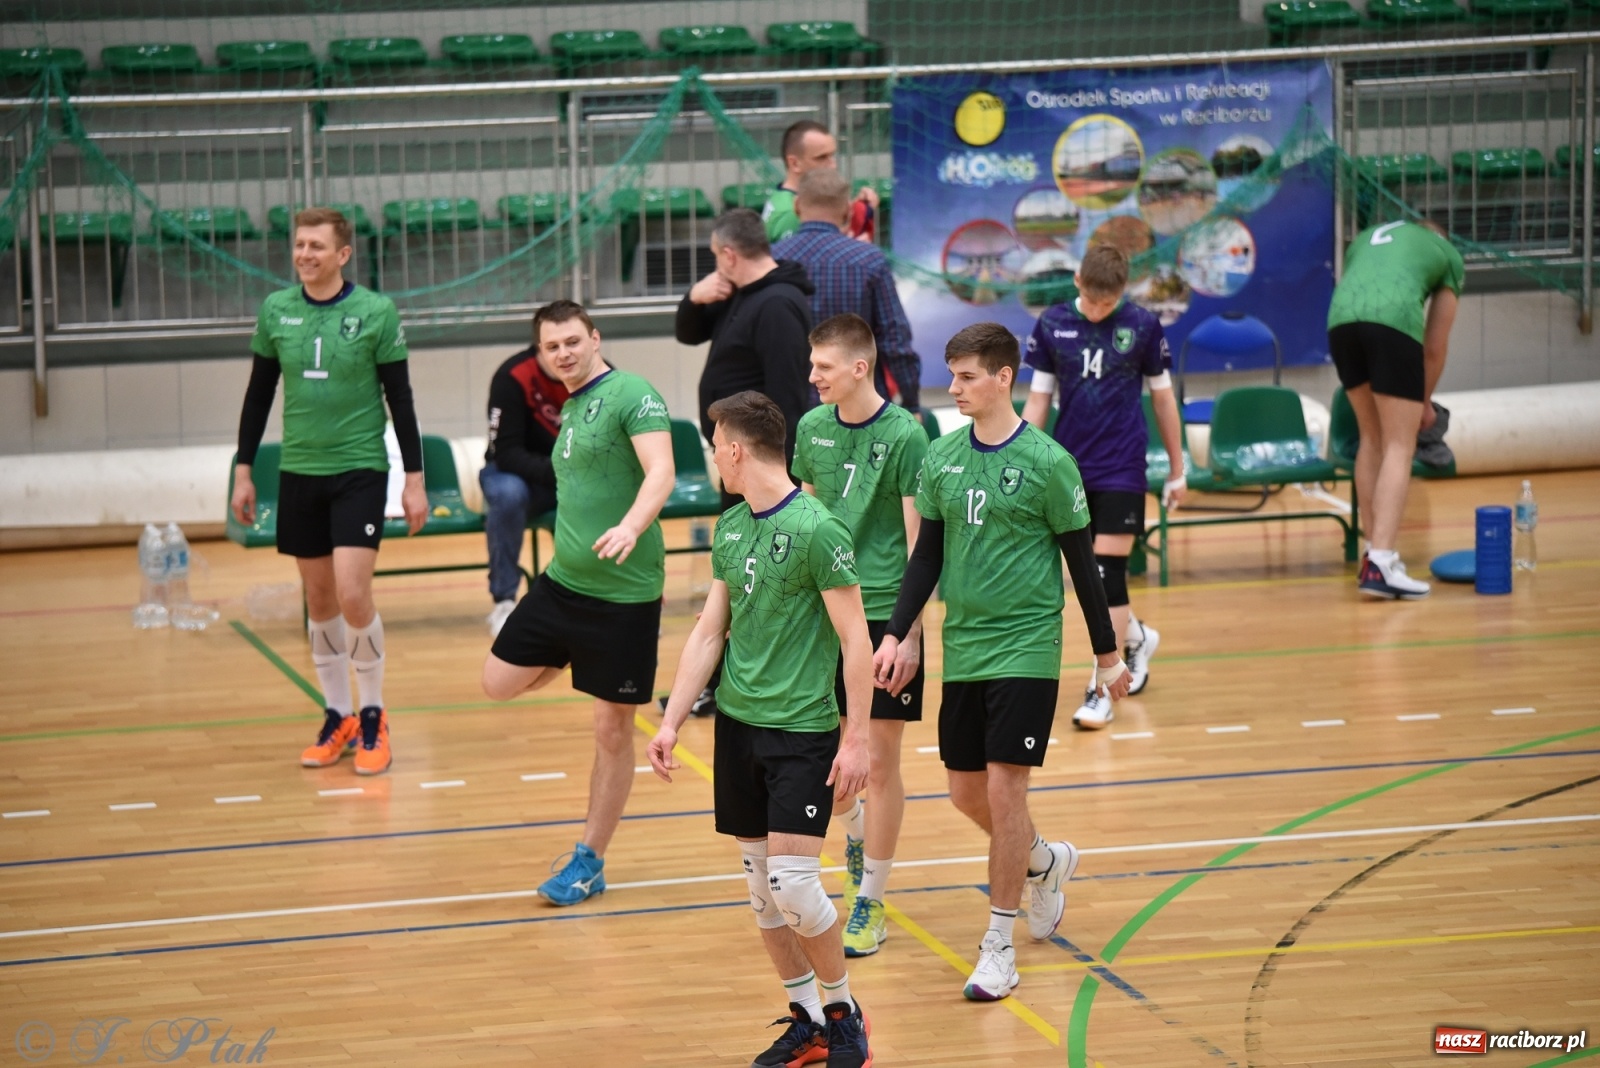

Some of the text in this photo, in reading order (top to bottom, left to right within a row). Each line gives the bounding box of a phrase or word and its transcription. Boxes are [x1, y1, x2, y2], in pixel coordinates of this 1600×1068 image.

[1109, 87, 1172, 109] Sportu
[313, 336, 323, 369] 1
[1081, 347, 1104, 380] 14
[562, 427, 574, 459] 3
[841, 463, 857, 498] 7
[966, 488, 987, 526] 12
[744, 557, 757, 595] 5
